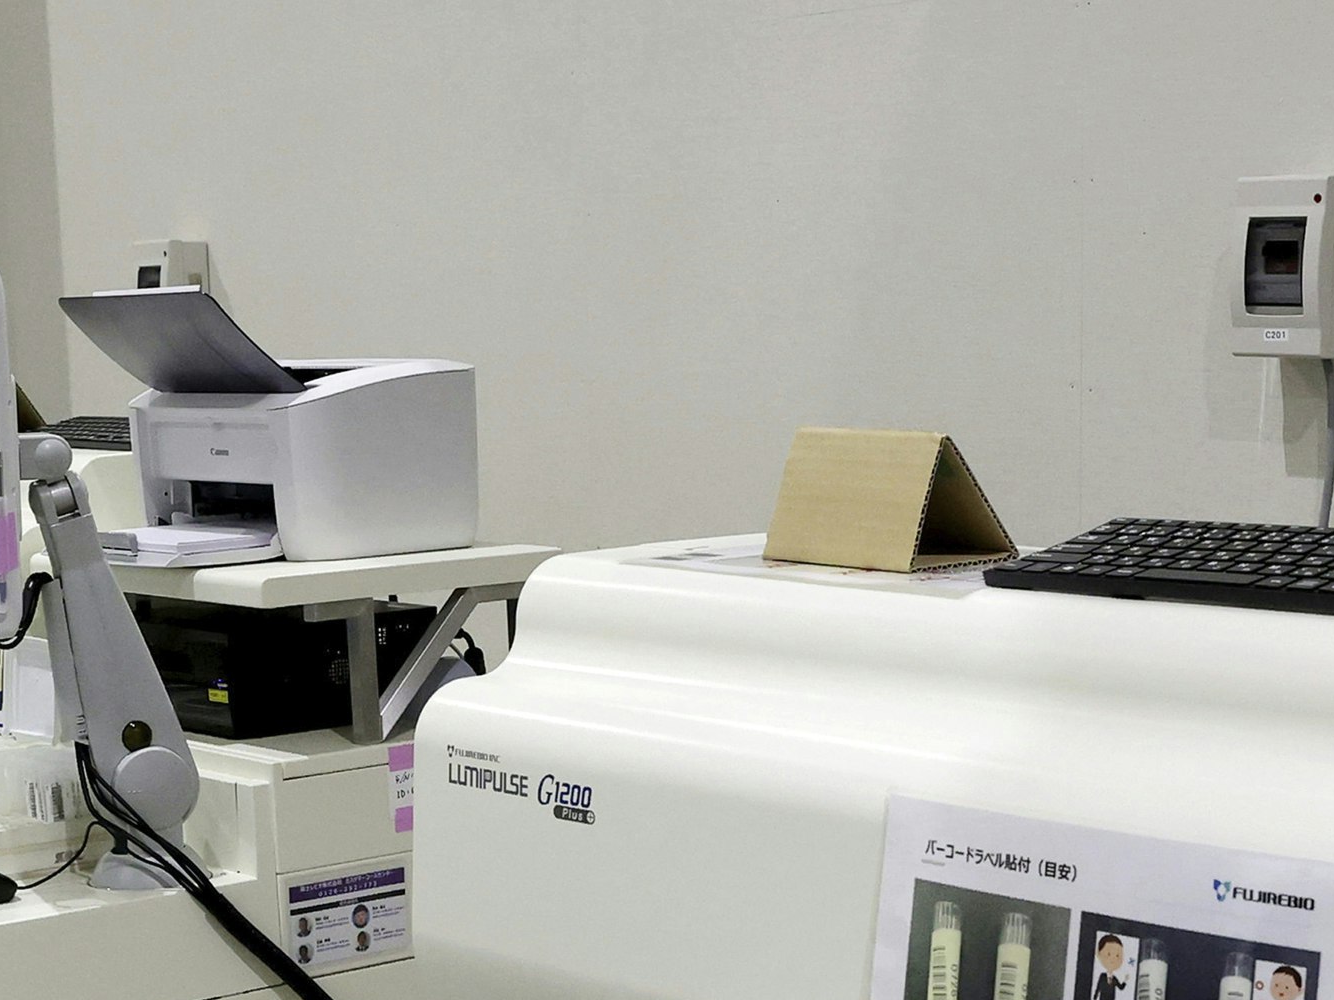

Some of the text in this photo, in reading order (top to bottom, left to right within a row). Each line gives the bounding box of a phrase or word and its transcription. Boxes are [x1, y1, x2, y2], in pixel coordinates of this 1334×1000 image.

[1265, 330, 1286, 339] C201
[448, 763, 593, 809] LUMIPULSE G1200
[561, 807, 584, 822] Plus
[1232, 886, 1315, 911] FUJIREBIO
